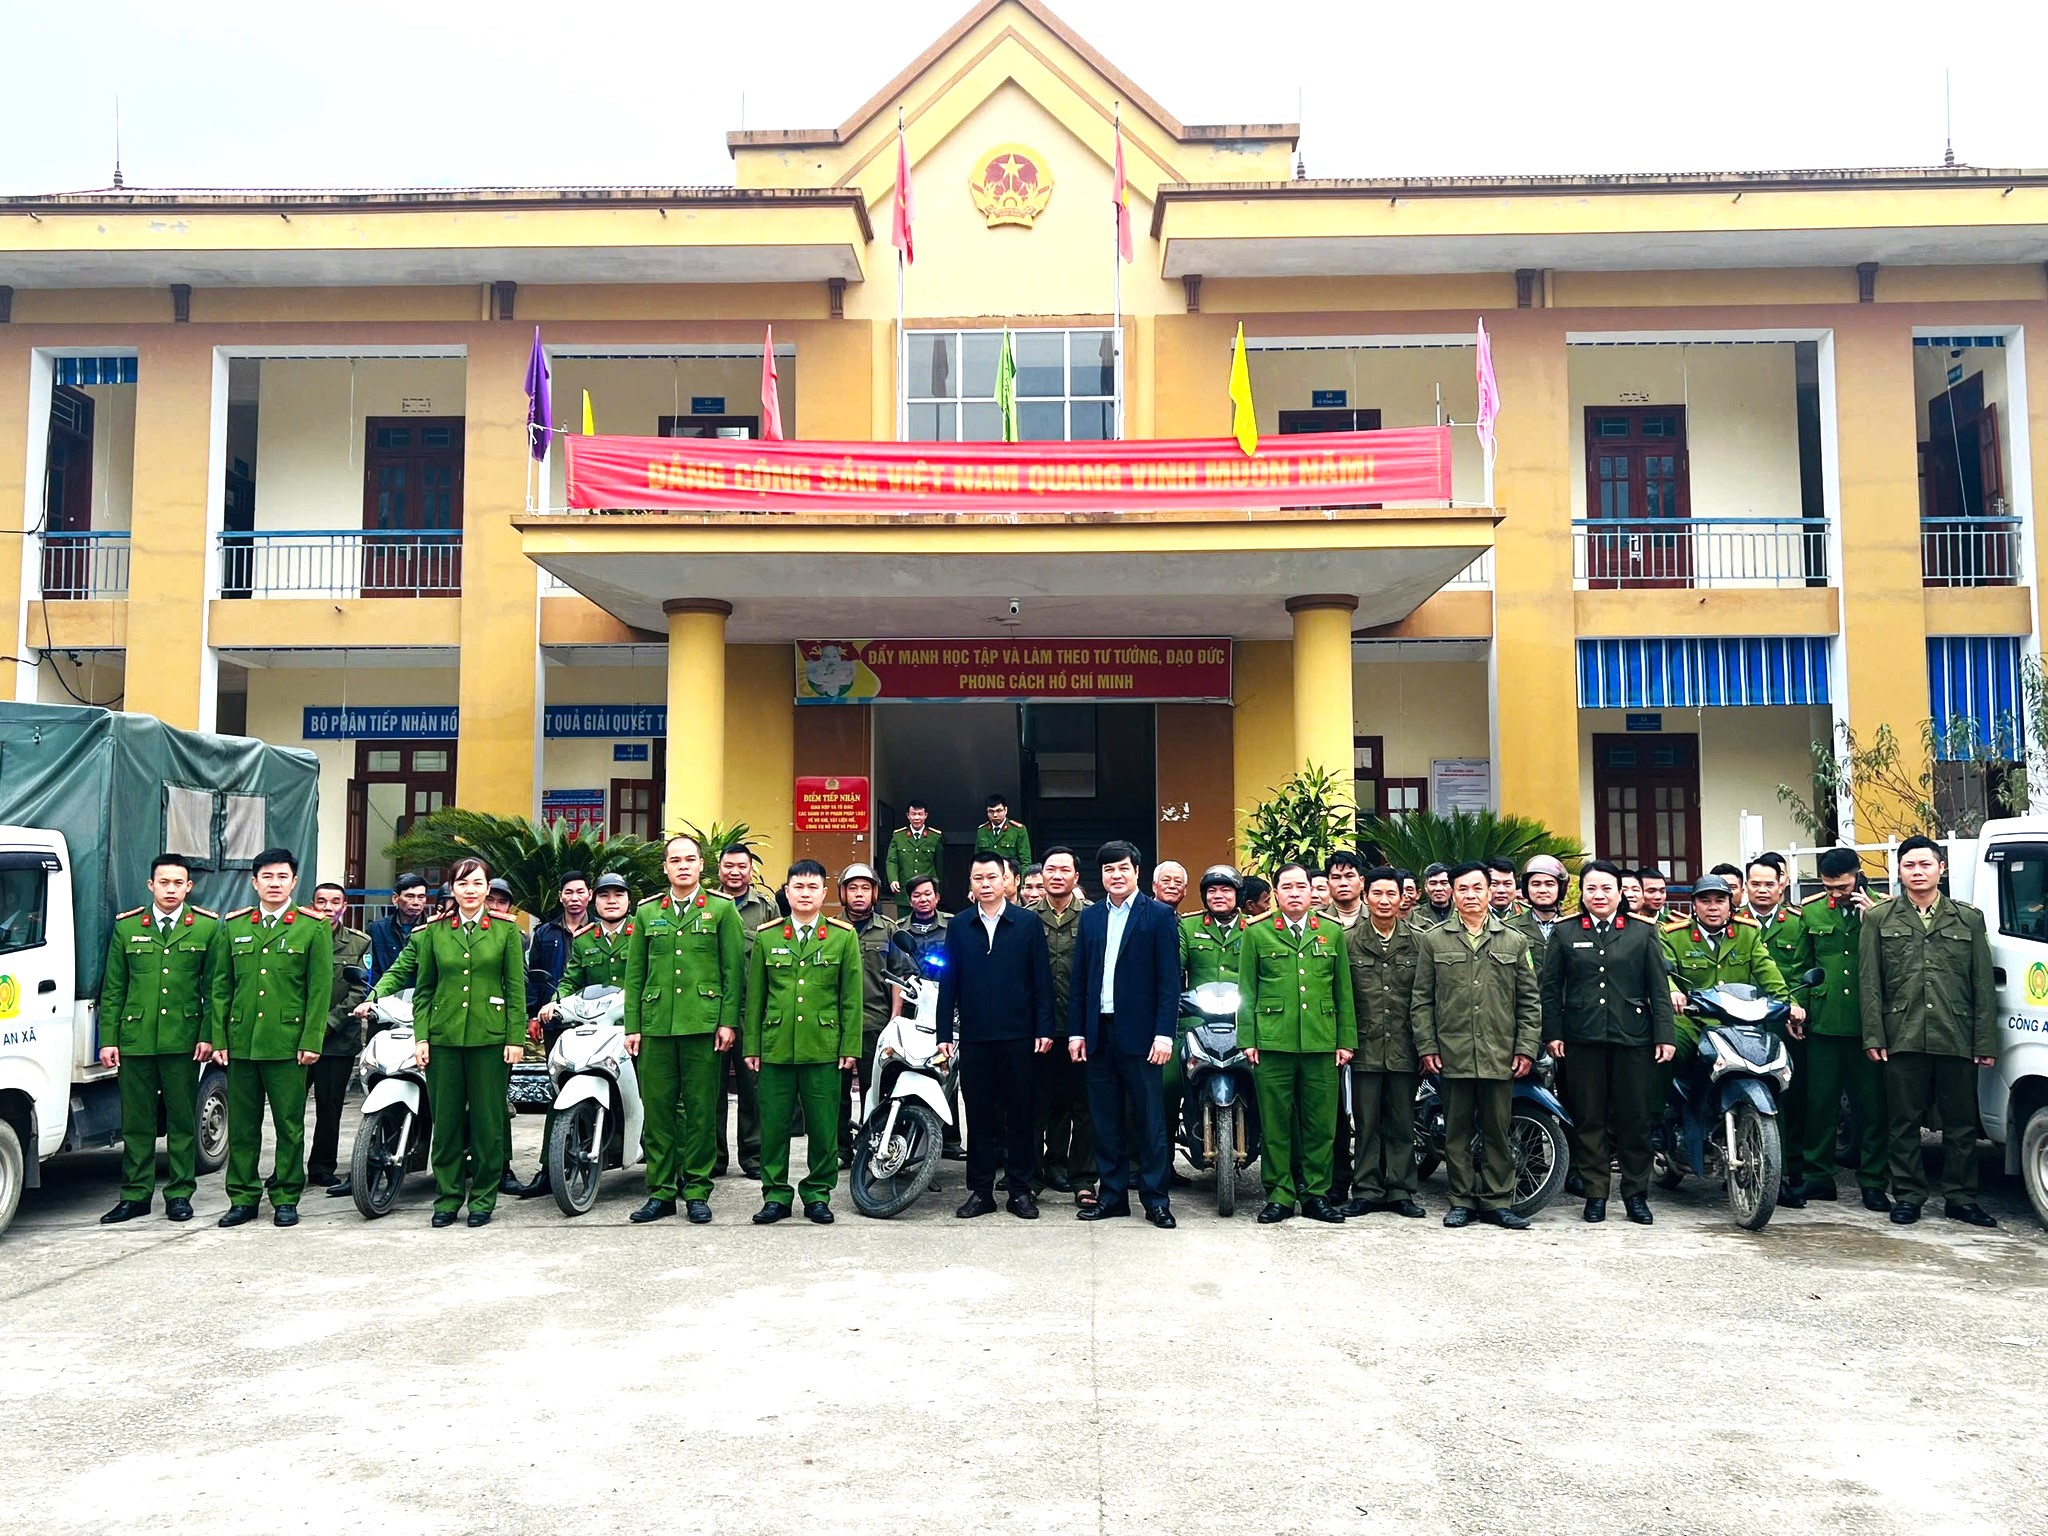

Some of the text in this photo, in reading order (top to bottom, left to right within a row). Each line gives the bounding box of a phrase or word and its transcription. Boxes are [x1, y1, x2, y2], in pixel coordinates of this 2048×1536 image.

[647, 450, 1375, 498] ĐẢNG CỘNG SẢN VIỆT NAM QUANG VINH MUÔN NĂM!
[868, 644, 1225, 668] ĐẨY MẠNH HỌC TẬP VÀ LÀM THEO TƯ TƯỞNG, ĐẠO ĐỨC
[959, 669, 1134, 689] PHONG CÁCH HỒ CHÍ MINH
[311, 709, 458, 736] BỘ PHẬN TIẾP NHẬN HỒ
[555, 708, 581, 732] QUẢ
[583, 708, 610, 731] GIẢI
[612, 709, 653, 732] QUYẾT
[823, 791, 839, 802] TIẾP
[840, 791, 861, 804] NHẬN
[3, 1027, 37, 1046] AN XÃ
[2041, 1021, 2048, 1033] A
